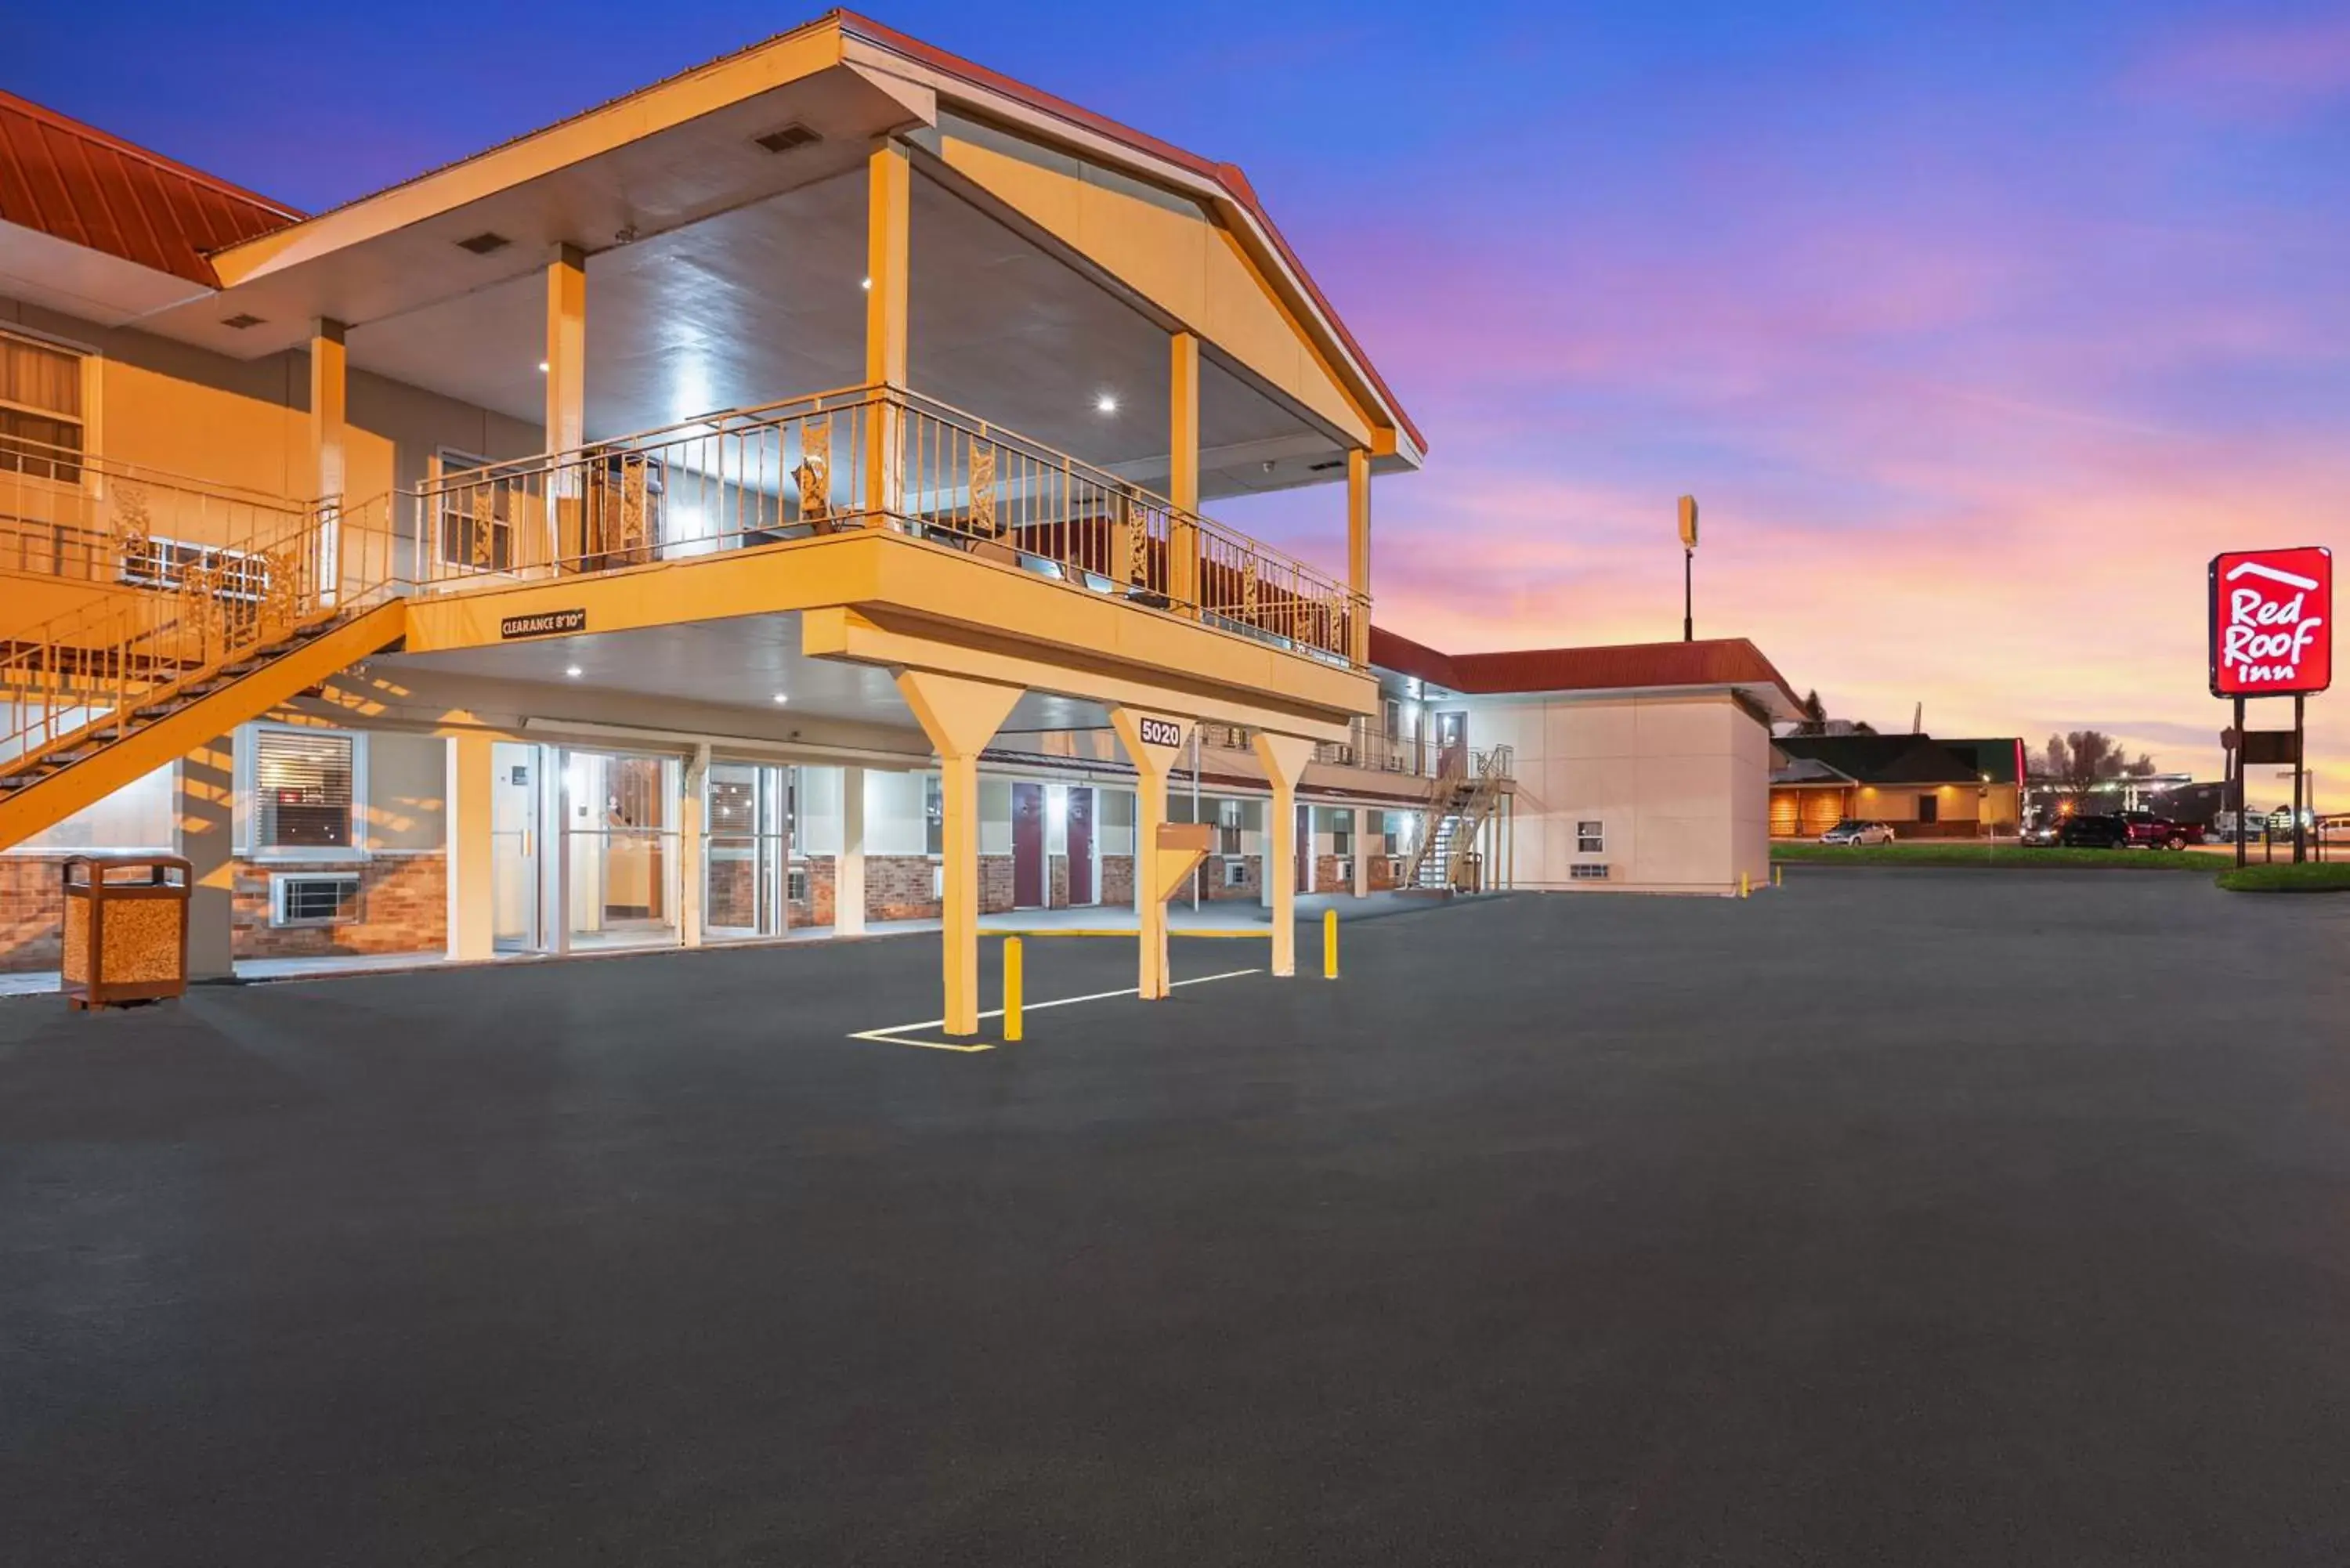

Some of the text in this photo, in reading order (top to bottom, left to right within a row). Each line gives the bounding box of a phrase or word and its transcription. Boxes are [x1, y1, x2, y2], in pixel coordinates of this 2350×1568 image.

[2231, 588, 2304, 627] Red
[502, 616, 555, 634] CLEARANCE
[2224, 617, 2322, 667] Roof
[1143, 721, 1179, 745] 5020
